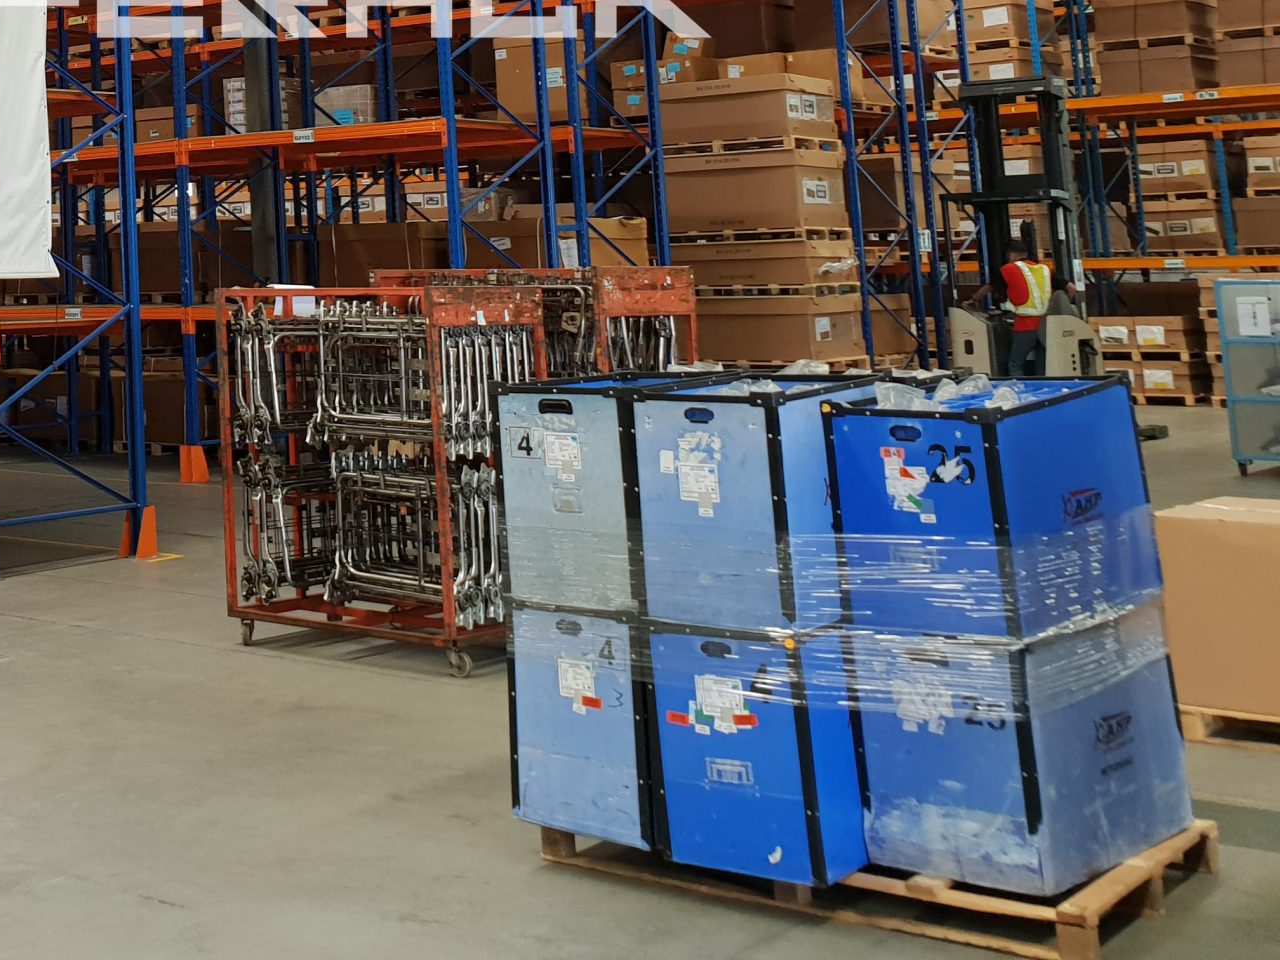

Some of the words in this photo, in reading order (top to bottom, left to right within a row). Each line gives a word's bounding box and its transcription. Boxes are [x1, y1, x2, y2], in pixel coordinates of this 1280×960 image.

[517, 431, 533, 457] 4
[927, 443, 976, 485] 25
[598, 640, 616, 666] 4
